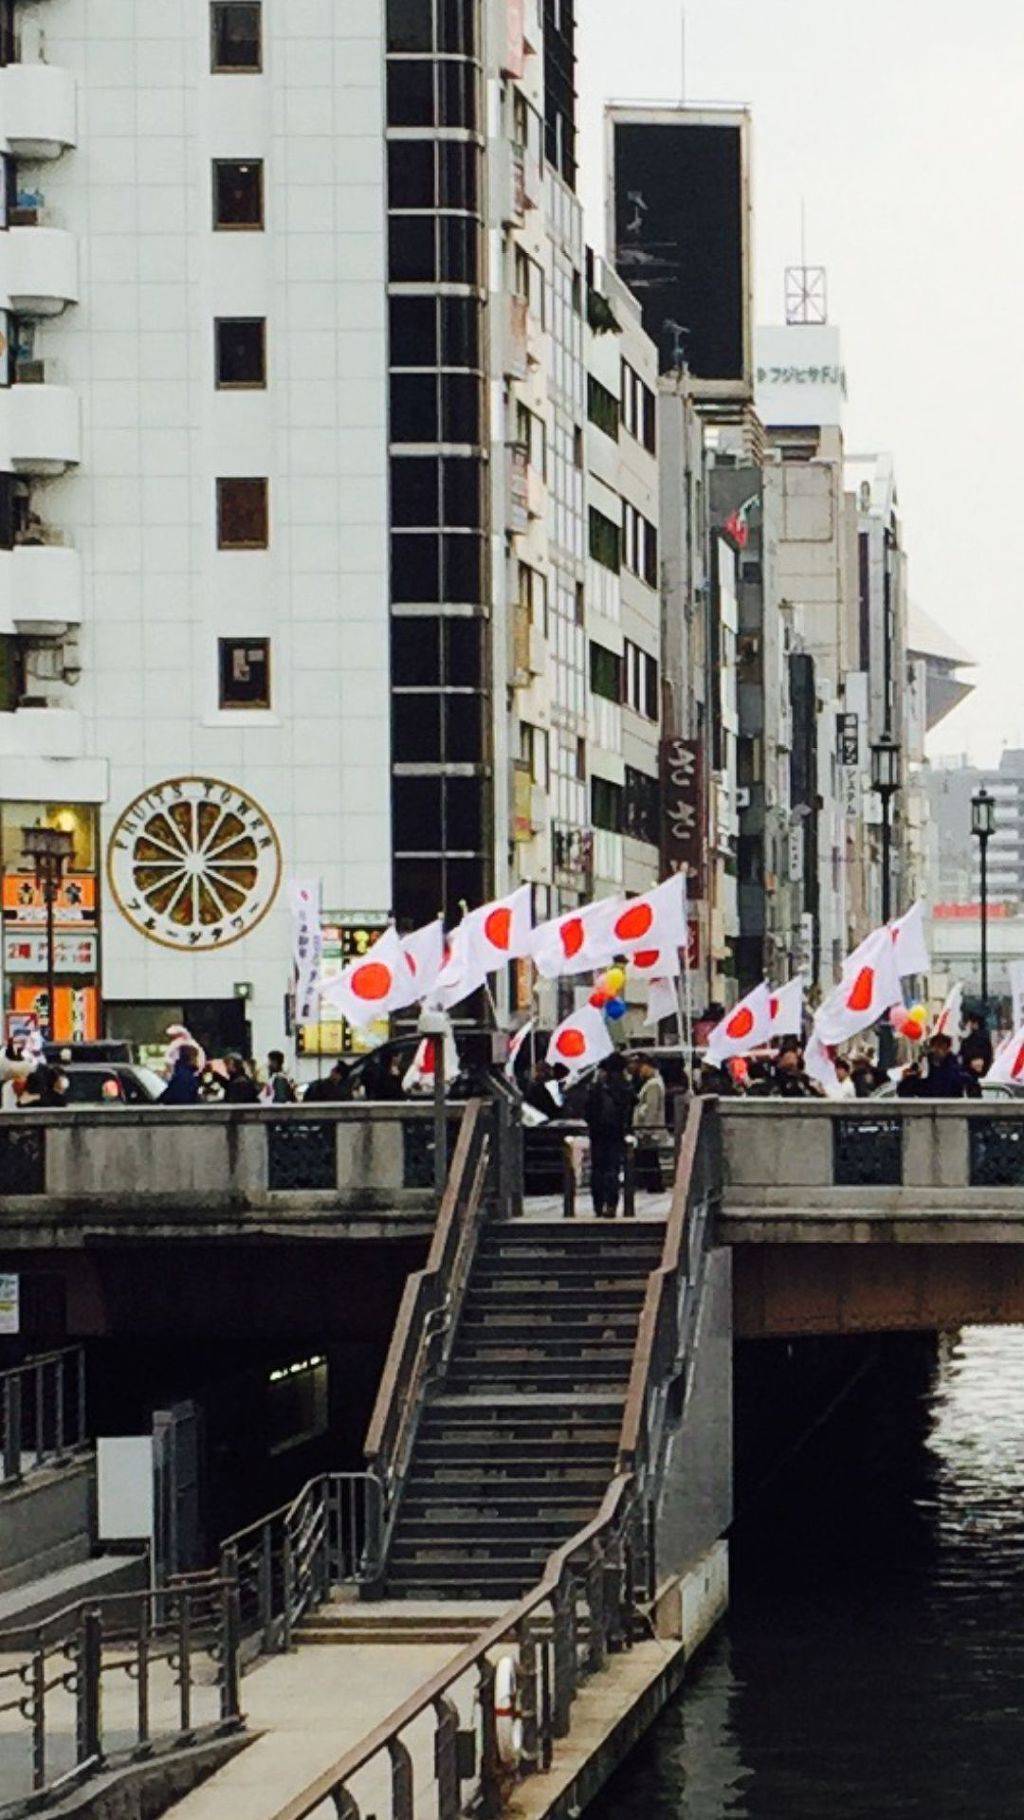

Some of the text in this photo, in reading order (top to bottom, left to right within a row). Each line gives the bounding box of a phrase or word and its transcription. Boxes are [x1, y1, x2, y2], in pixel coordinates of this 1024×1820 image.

[115, 780, 273, 850] FRUITS TOWER
[18, 882, 82, 905] 吉家
